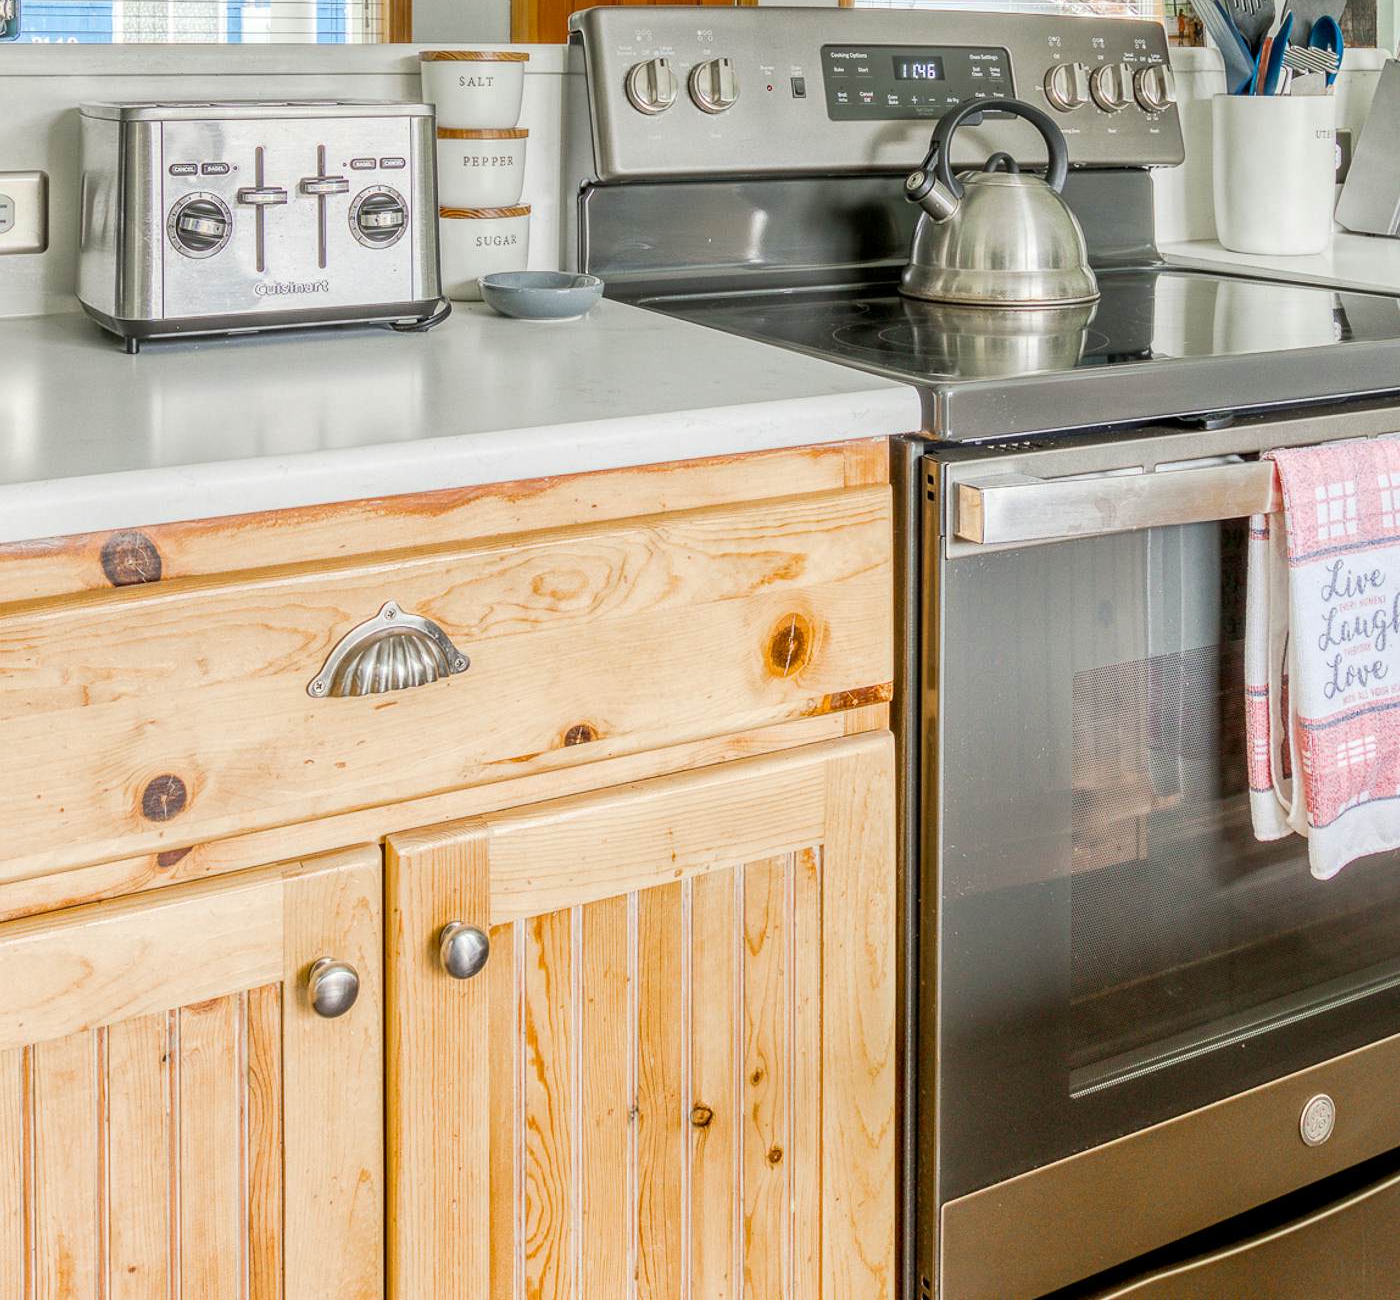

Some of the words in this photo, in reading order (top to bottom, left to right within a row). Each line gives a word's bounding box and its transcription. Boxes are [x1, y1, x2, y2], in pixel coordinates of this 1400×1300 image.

[830, 52, 850, 60] Cooking
[850, 52, 868, 60] Options
[459, 76, 494, 87] SALT
[463, 156, 513, 167] PEPPER
[476, 235, 517, 247] SUGAR
[255, 279, 329, 297] Cuisinart
[1321, 559, 1386, 601] Live
[1324, 653, 1389, 699] Love
